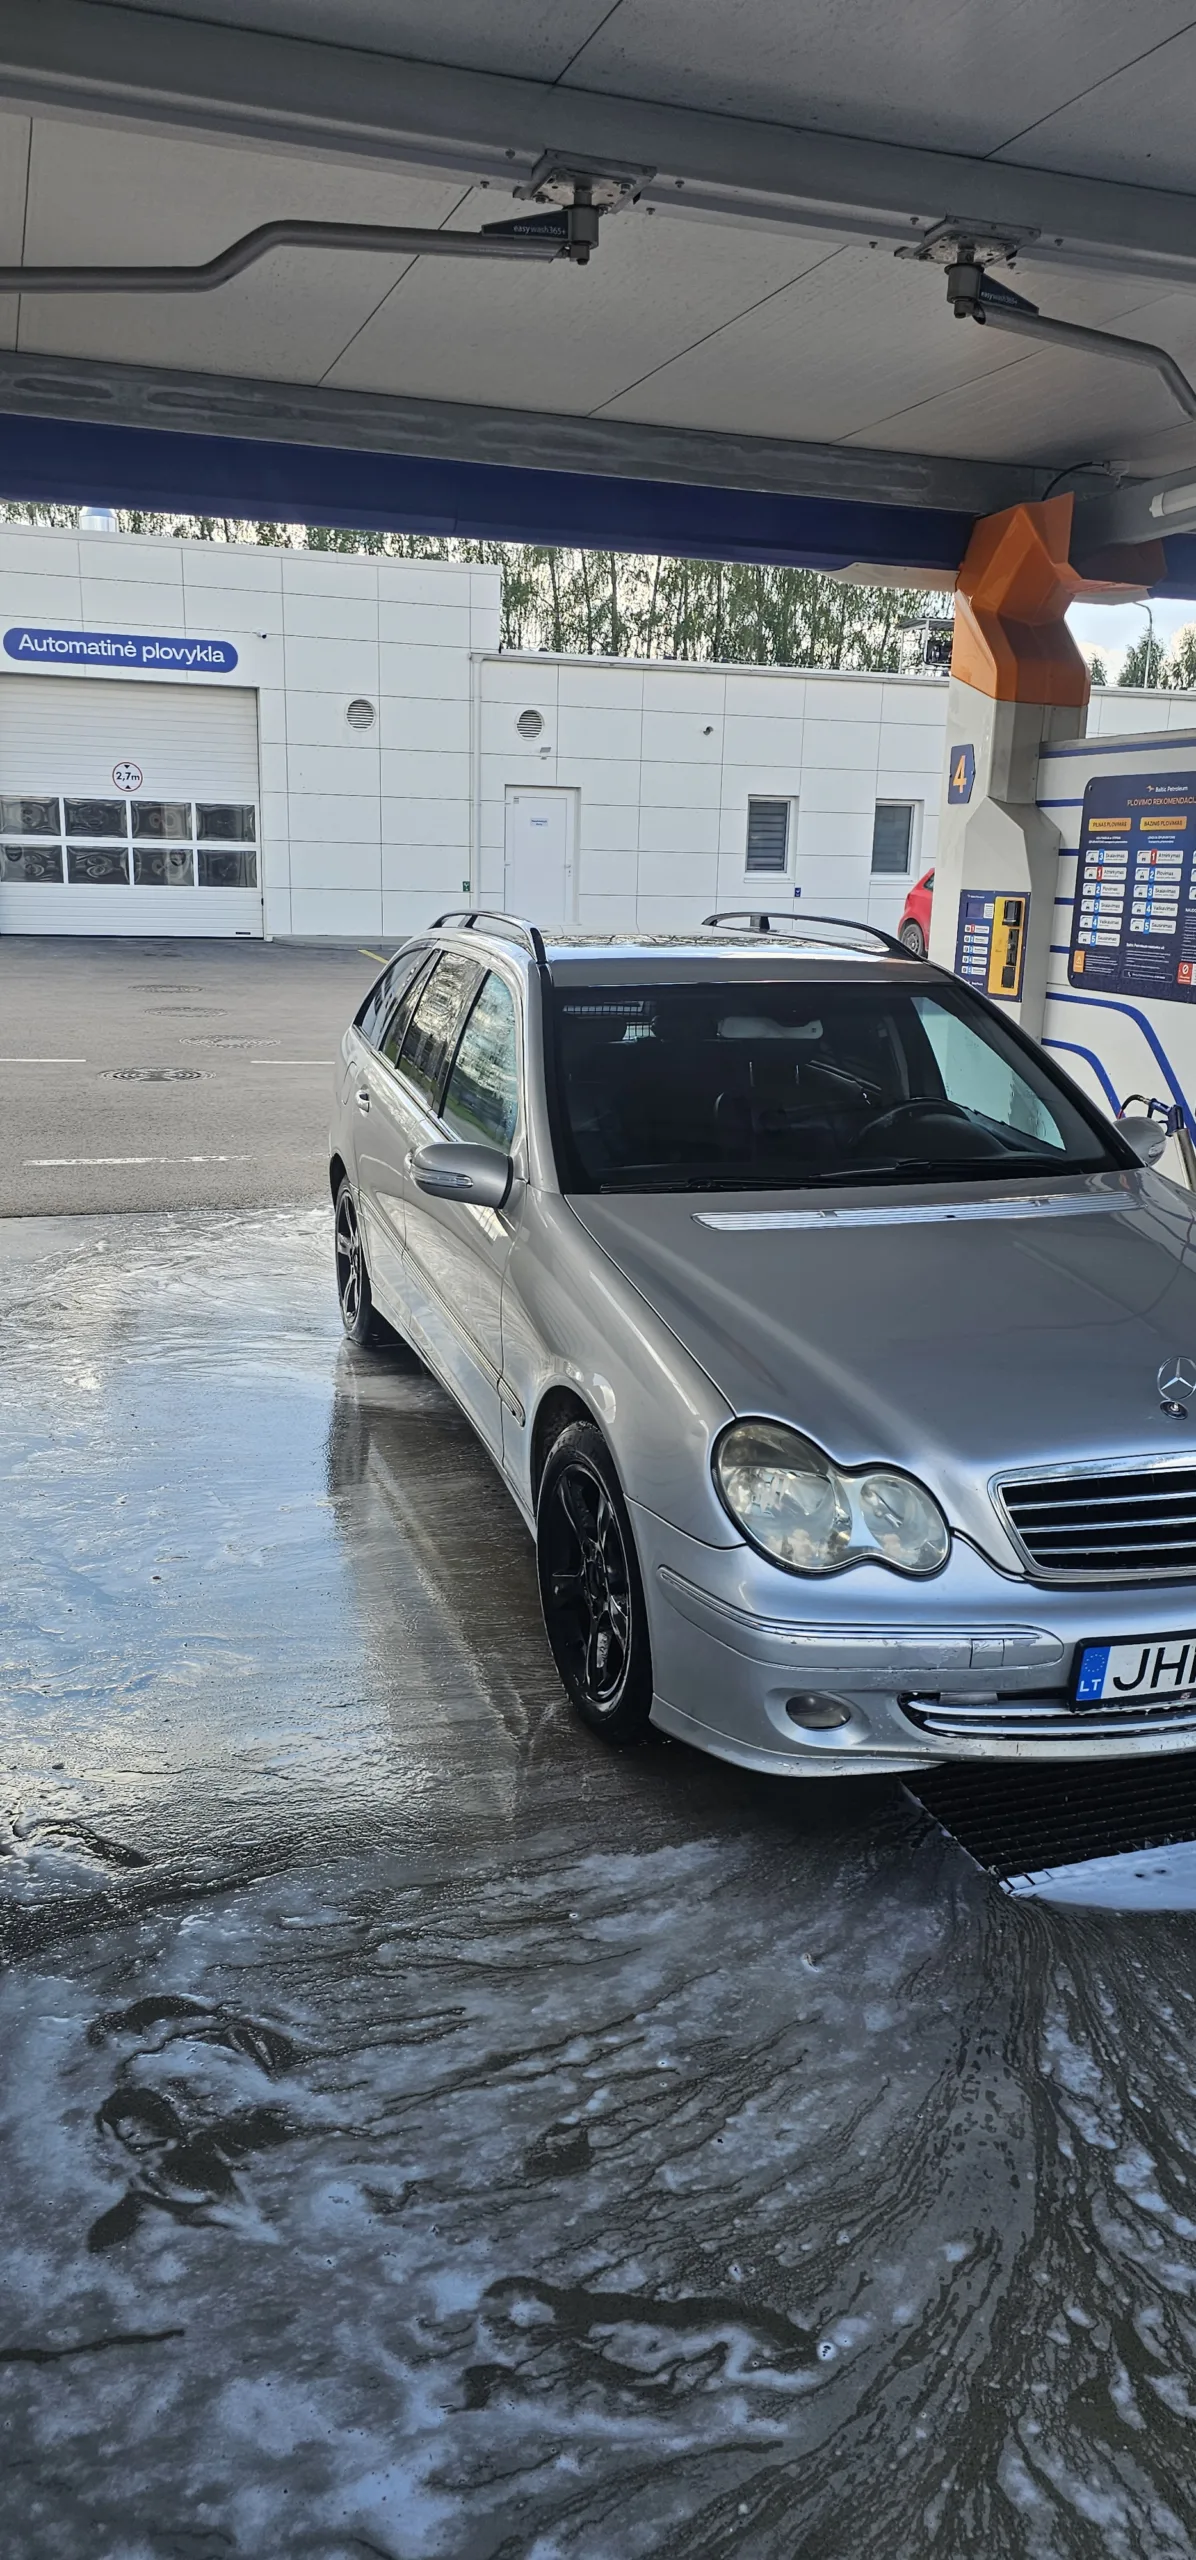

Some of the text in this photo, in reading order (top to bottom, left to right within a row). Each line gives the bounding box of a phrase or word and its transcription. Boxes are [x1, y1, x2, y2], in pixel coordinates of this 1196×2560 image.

[18, 634, 225, 665] Automatinė plovykla
[116, 771, 140, 781] 2,7m
[952, 754, 967, 794] 4
[1127, 798, 1152, 806] PLOVIMO
[1097, 869, 1101, 877] 1
[1096, 886, 1100, 894] 2
[1144, 922, 1149, 930] 5
[1091, 935, 1096, 943] 5
[1112, 1644, 1196, 1691] JH
[1080, 1679, 1101, 1692] LT
